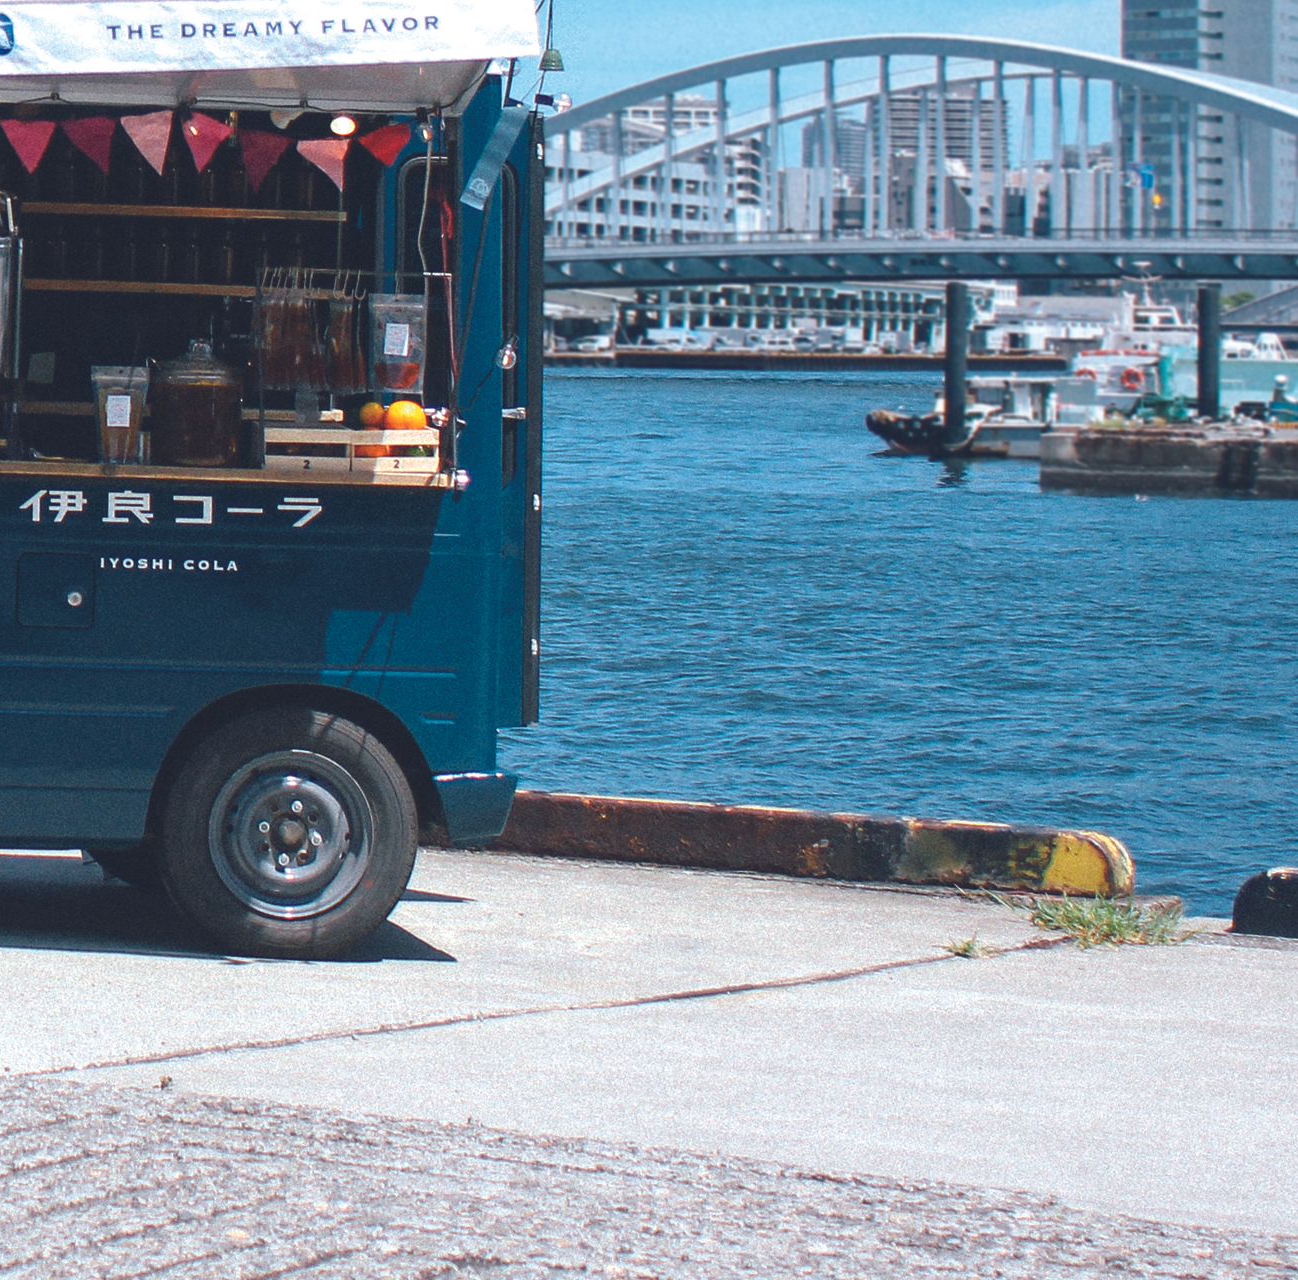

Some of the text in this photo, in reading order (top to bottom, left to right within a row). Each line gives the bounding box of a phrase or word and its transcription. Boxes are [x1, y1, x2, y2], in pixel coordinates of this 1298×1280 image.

[106, 14, 441, 39] THE DREAMY FLAVOR
[303, 459, 311, 469] 2
[393, 459, 400, 469] 2
[18, 489, 323, 528] 伊良コーラ
[100, 557, 238, 571] IYOSHI COLA
